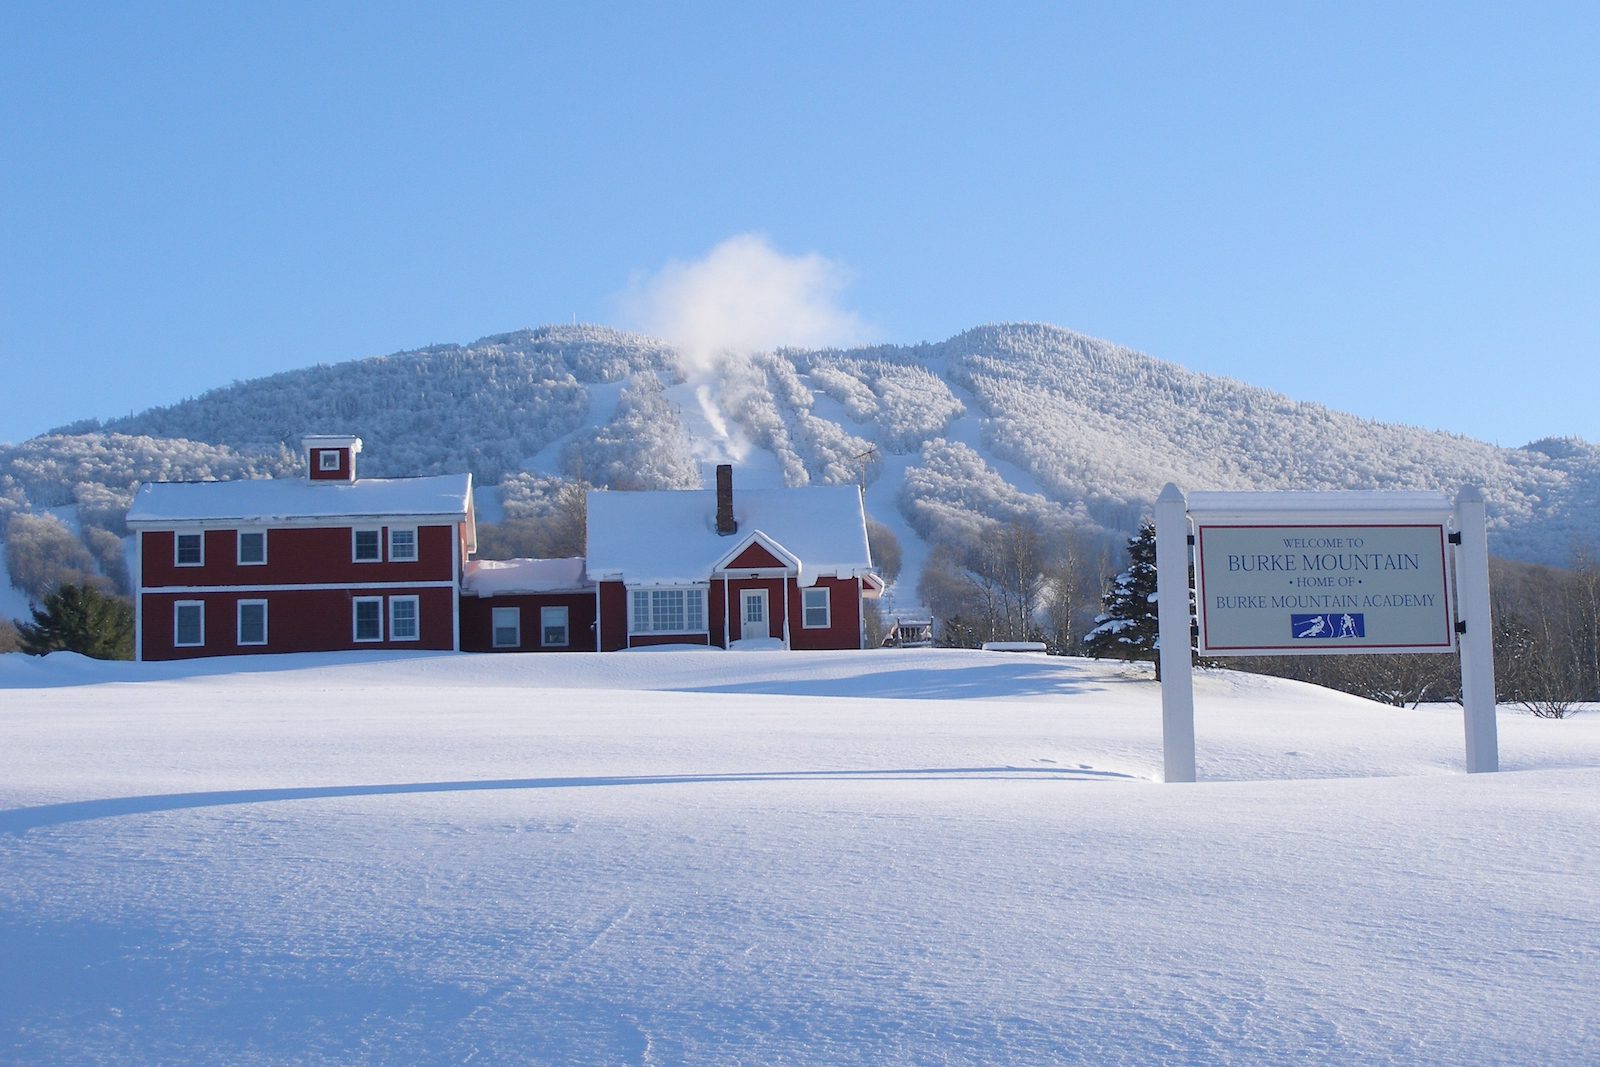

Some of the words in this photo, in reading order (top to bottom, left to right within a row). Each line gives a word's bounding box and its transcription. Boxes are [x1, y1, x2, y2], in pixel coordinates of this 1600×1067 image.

[1283, 538, 1344, 549] WELCOME
[1348, 538, 1364, 548] TO
[1228, 554, 1297, 572] BURKE
[1302, 553, 1419, 571] MOUNTAIN
[1297, 577, 1336, 588] HOME
[1338, 577, 1355, 587] OF
[1216, 596, 1267, 609] BURKE
[1271, 595, 1359, 608] MOUNTAIN
[1363, 594, 1435, 607] ACADEMY
